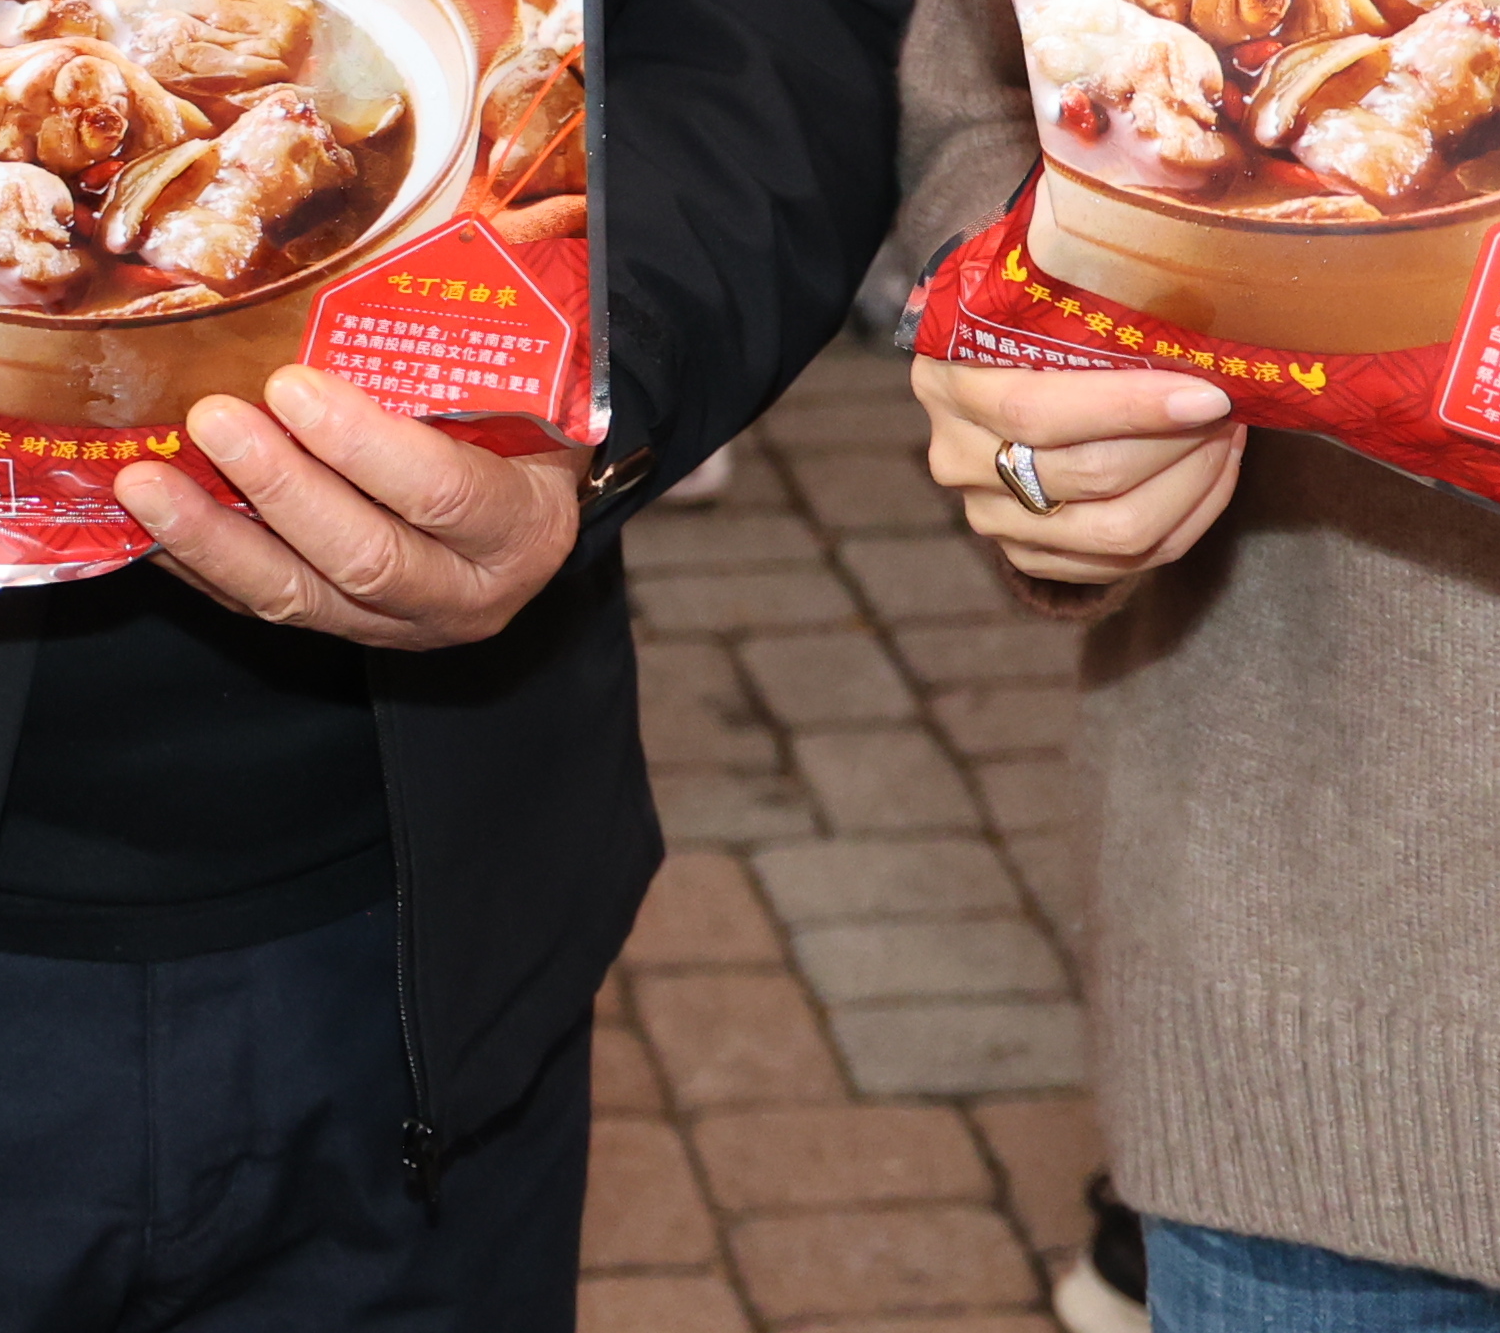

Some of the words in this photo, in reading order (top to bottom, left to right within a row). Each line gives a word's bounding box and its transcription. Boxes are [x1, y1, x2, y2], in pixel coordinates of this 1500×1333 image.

[387, 271, 519, 310] 吃丁酒由來
[1023, 281, 1145, 352] 平平安安
[19, 436, 140, 461] 財源滾滾
